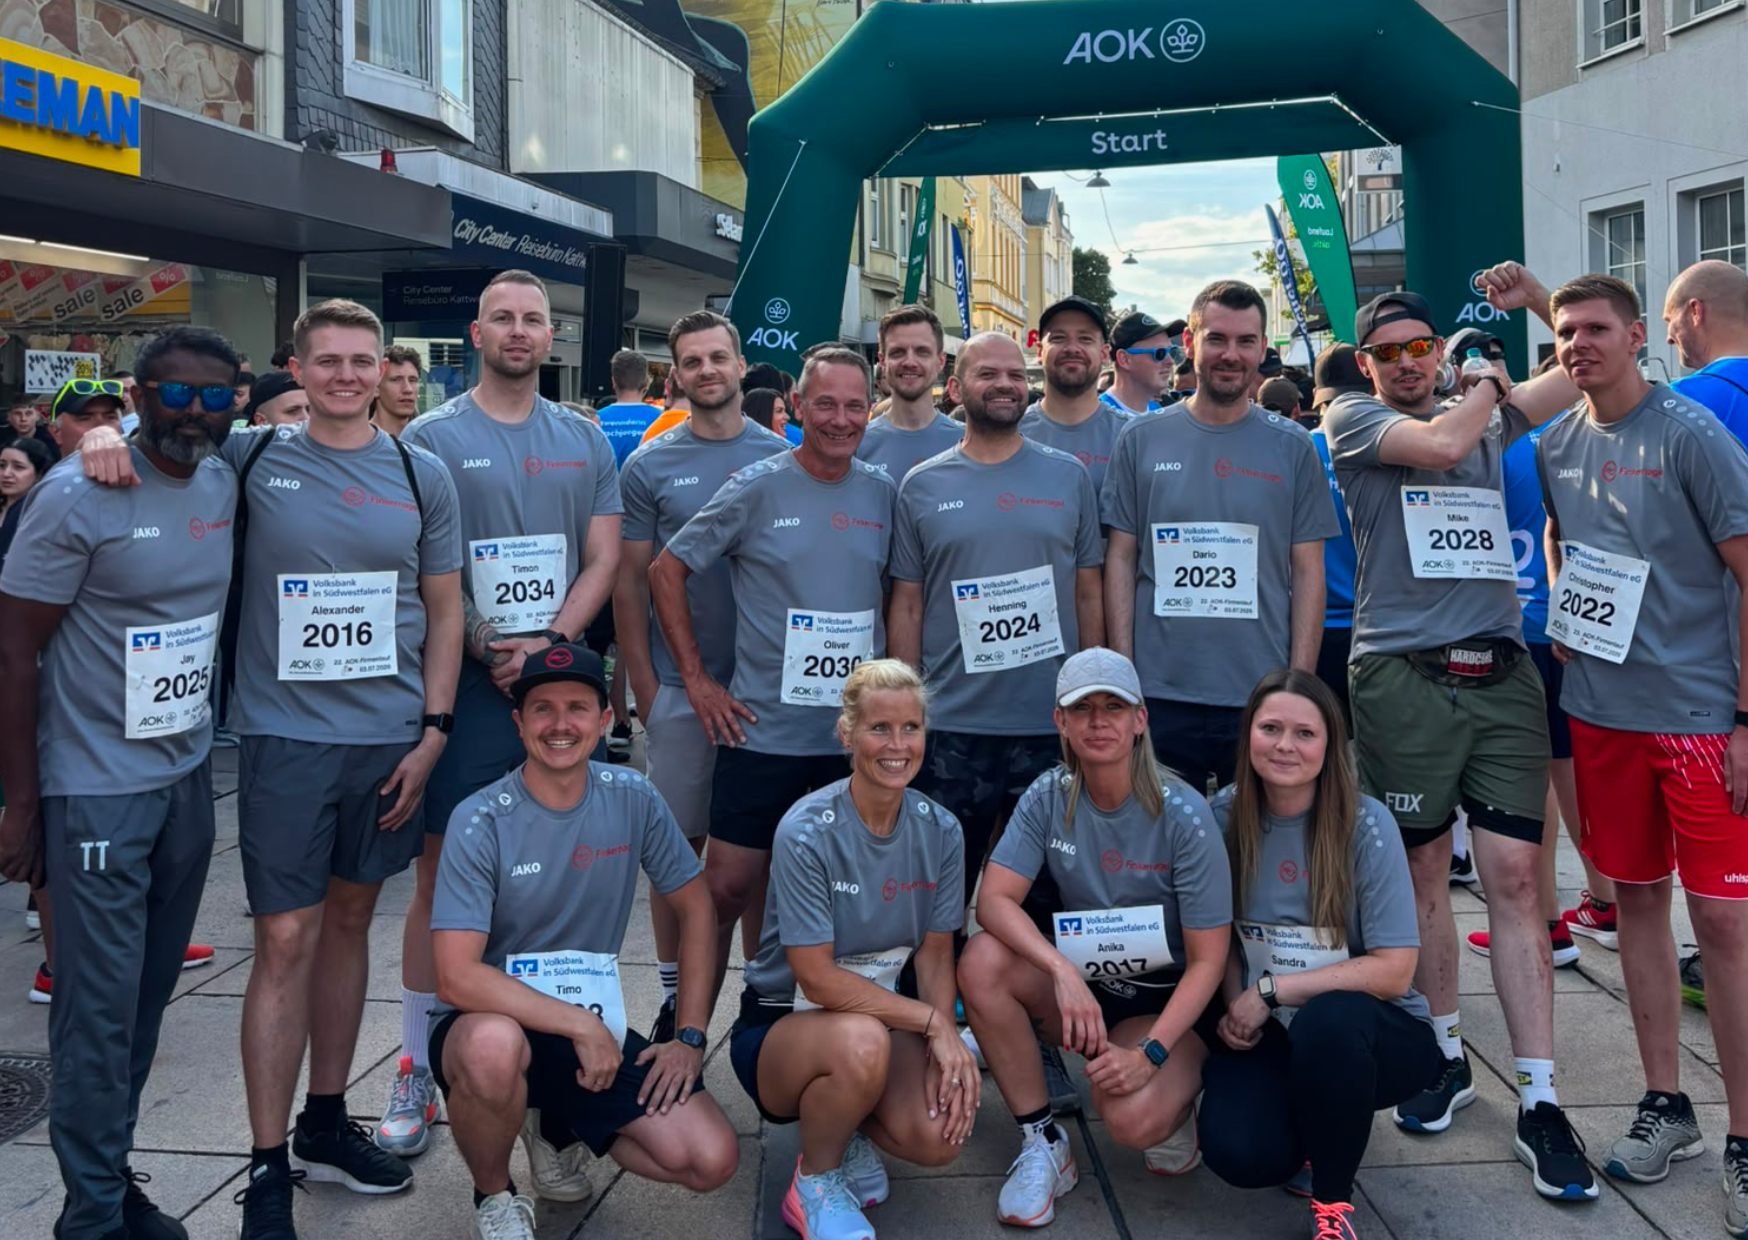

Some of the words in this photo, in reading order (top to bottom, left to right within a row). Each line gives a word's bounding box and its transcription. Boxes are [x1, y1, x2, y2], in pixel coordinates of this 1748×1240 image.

[1063, 27, 1155, 65] AOK
[0, 58, 139, 149] EMAN
[1091, 129, 1168, 154] Start
[454, 219, 481, 245] City
[478, 225, 518, 251] Center
[515, 235, 562, 263] Reisebüro
[403, 285, 421, 296] City
[422, 285, 453, 294] Center
[54, 288, 96, 319] sale
[101, 288, 144, 320] sale
[1455, 301, 1511, 323] AOK
[747, 327, 800, 351] AOK
[462, 458, 491, 469] JAKO
[1154, 462, 1182, 472] JAKO
[1558, 467, 1582, 479] JAKO
[267, 477, 300, 490] JAKO
[673, 476, 699, 487] JAKO
[1432, 491, 1470, 499] Volksbank
[937, 500, 964, 512] JAKO
[1443, 499, 1491, 509] Südwestfalen
[773, 518, 800, 528] JAKO
[1446, 513, 1470, 523] Mike
[133, 527, 160, 539] JAKO
[1182, 526, 1220, 535] Volksbank
[502, 540, 538, 550] Volksbank
[1191, 536, 1241, 545] Südwestfalen
[1428, 529, 1495, 551] 2028
[502, 551, 511, 559] in
[1192, 550, 1217, 559] Dario
[511, 564, 540, 574] Timon
[1422, 560, 1444, 569] AOK
[1580, 558, 1629, 580] Südwestfalen
[1629, 575, 1642, 584] eG
[312, 579, 357, 588] Volksbank
[1174, 566, 1237, 589] 2023
[1568, 571, 1616, 595] Christopher
[981, 578, 1019, 590] Volksbank
[992, 583, 1040, 597] Südwestfalen
[1041, 578, 1051, 587] eG
[323, 587, 380, 598] Südwestfalen
[381, 586, 392, 595] eG
[495, 578, 555, 605] 2034
[988, 600, 1027, 613] Henning
[1163, 598, 1183, 607] AOK
[1559, 588, 1616, 627] 2022
[311, 604, 366, 616] Alexander
[488, 615, 508, 625] AOK
[817, 616, 853, 625] Volksbank
[165, 625, 202, 639] Volksbank
[980, 612, 1042, 644] 2024
[302, 621, 374, 649] 2016
[165, 640, 174, 649] in
[823, 640, 851, 650] Oliver
[180, 654, 196, 665] Jay
[974, 652, 994, 663] AOK
[289, 659, 312, 670] AOK
[153, 664, 209, 703] 2025
[791, 686, 812, 696] AOK
[138, 714, 164, 727] AOK
[1385, 791, 1424, 813] FOX
[1050, 838, 1077, 855] JAKO
[80, 840, 110, 870] TT
[511, 862, 542, 877] JAKO
[1085, 915, 1123, 925] Volksbank
[1086, 927, 1094, 935] in
[1095, 924, 1147, 935] Südwestfalen
[1148, 922, 1160, 931] eG
[1097, 943, 1125, 953] Anika
[1273, 939, 1328, 951] Südwestfalen
[543, 956, 584, 967] Volksbank
[1271, 954, 1307, 968] Sandra
[543, 968, 552, 977] in
[553, 967, 605, 977] Südwestfalen
[605, 969, 616, 977] eG
[1085, 958, 1147, 978] 2017
[556, 984, 582, 995] Timo
